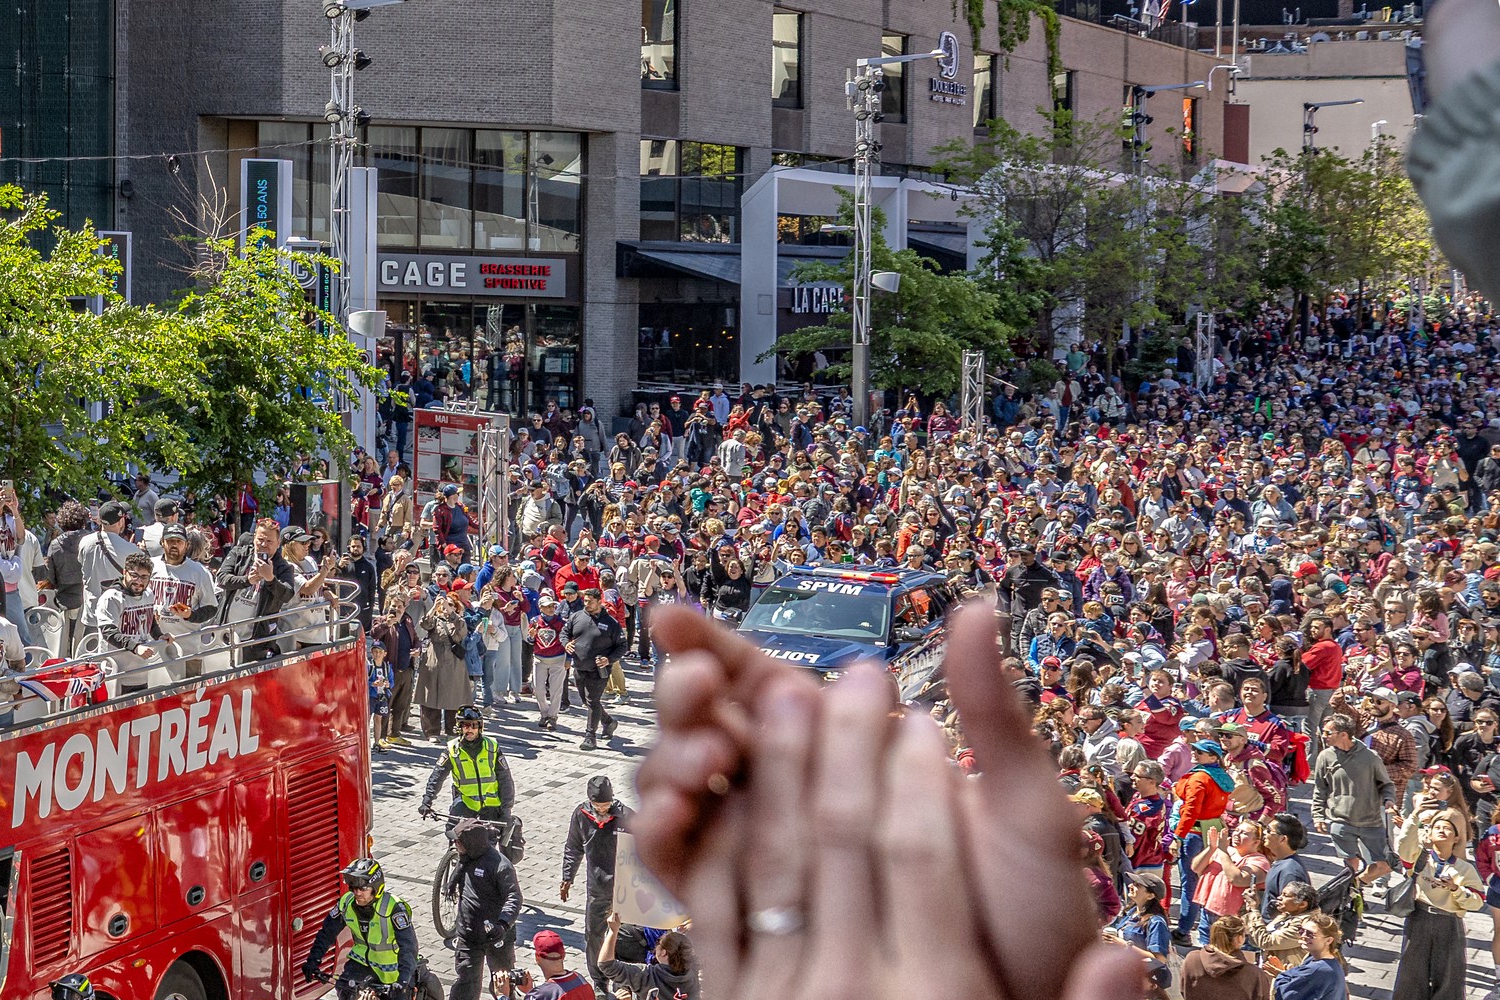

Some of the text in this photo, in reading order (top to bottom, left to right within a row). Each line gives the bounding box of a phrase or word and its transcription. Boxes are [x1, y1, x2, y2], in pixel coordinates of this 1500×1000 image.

[257, 179, 267, 203] ANS
[257, 205, 267, 219] 50
[381, 260, 466, 287] CAGE
[480, 263, 551, 276] BRASSERIE
[484, 277, 547, 290] SPORTIVE
[794, 288, 809, 313] LA
[435, 415, 448, 423] MAI
[797, 581, 863, 595] SPVM
[11, 687, 260, 829] MONTRÉAL
